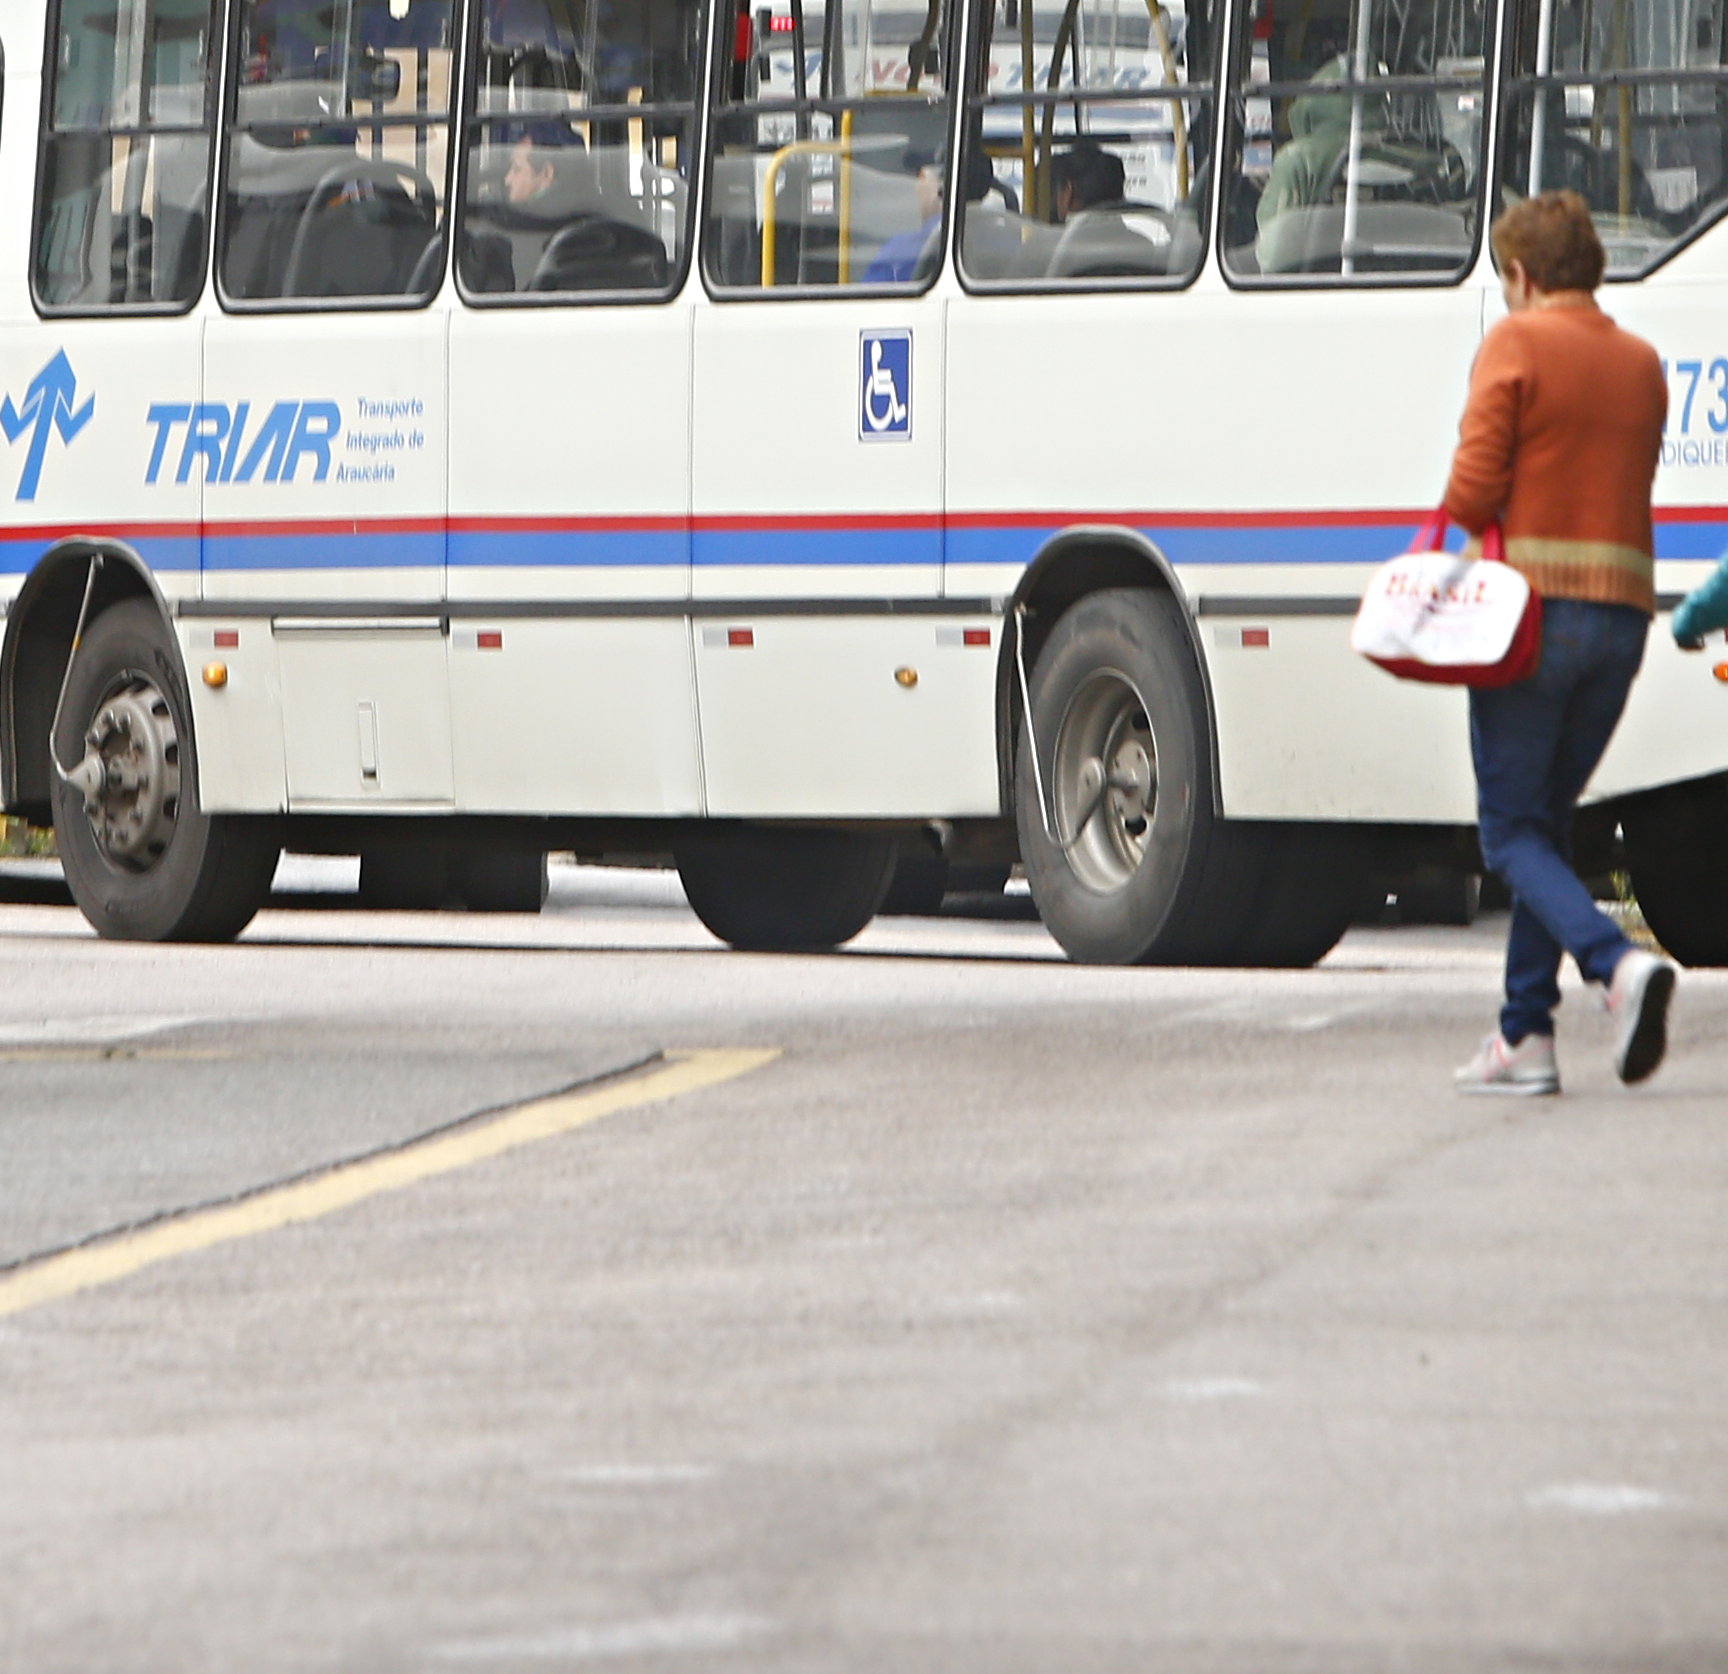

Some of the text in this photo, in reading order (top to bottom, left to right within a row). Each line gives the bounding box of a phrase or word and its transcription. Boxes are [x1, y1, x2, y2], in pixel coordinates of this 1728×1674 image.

[357, 398, 423, 423] Transporte
[143, 399, 340, 486] TRIAR
[346, 428, 424, 455] Integrado de
